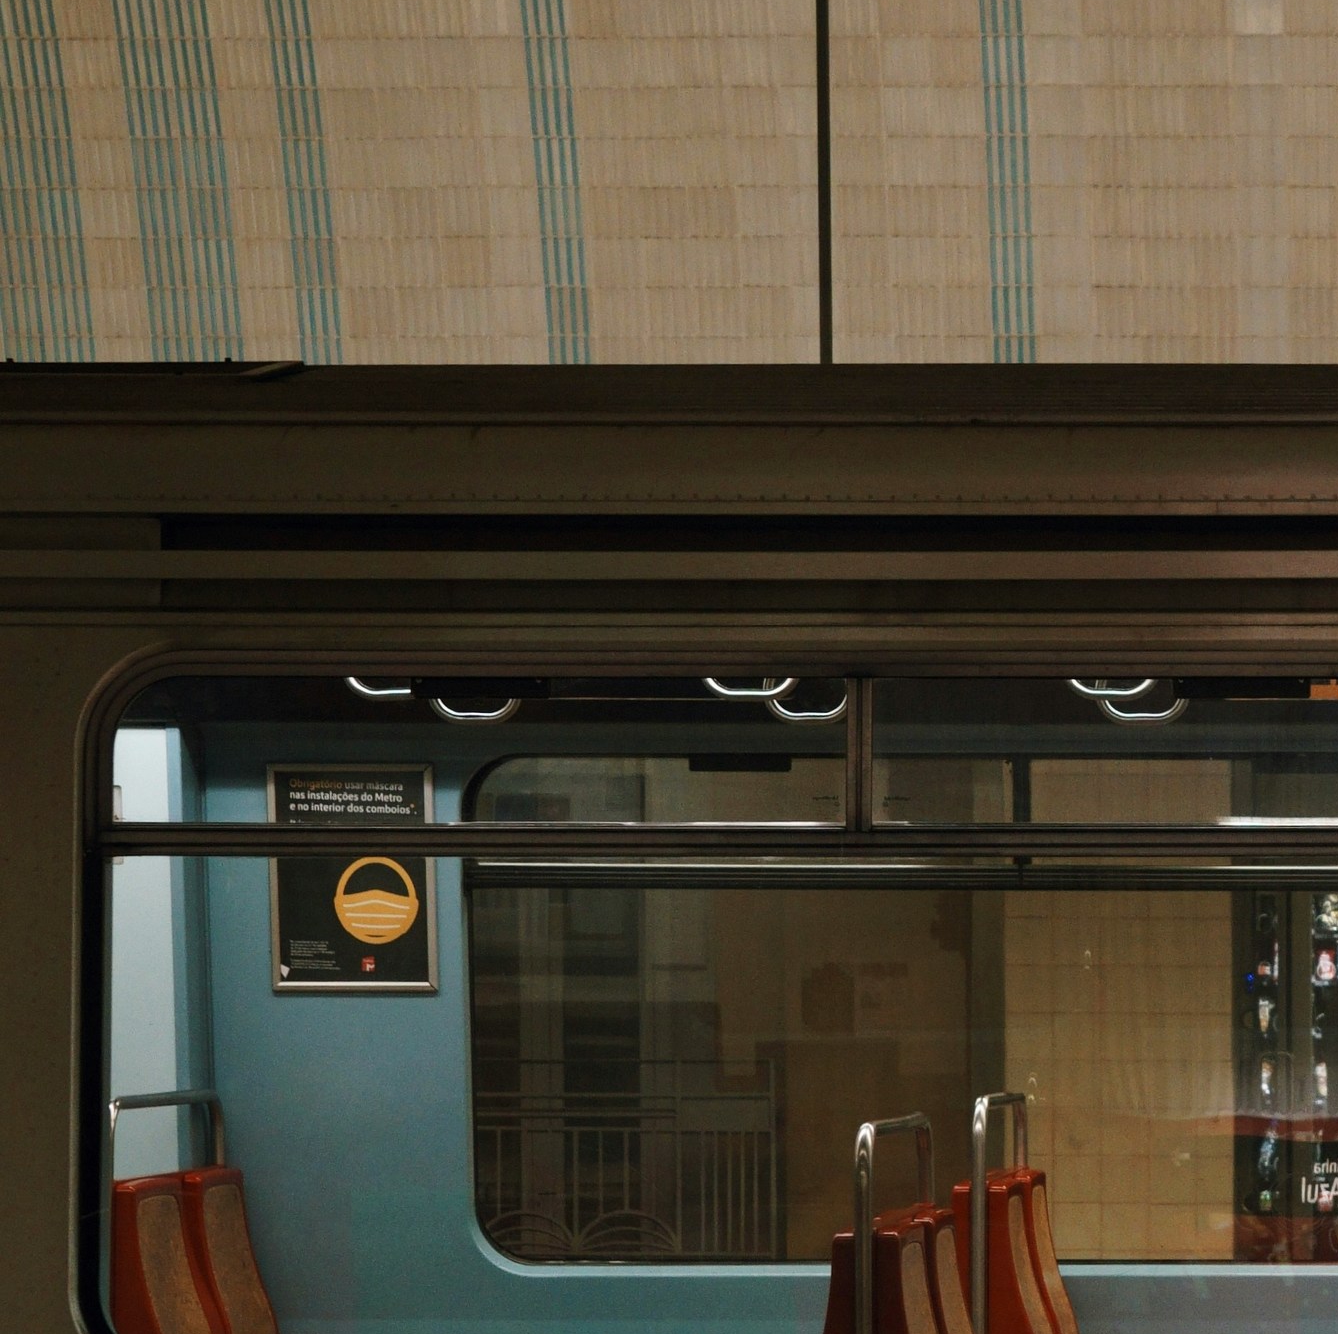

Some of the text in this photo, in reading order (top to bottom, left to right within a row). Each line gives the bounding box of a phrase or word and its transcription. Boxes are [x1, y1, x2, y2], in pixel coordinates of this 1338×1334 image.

[289, 778, 404, 791] Obrigatório usar máscara
[289, 790, 403, 803] nas instalações do Metro
[289, 803, 296, 811] e
[297, 803, 310, 811] no
[311, 802, 345, 813] interior
[346, 802, 364, 813] dos
